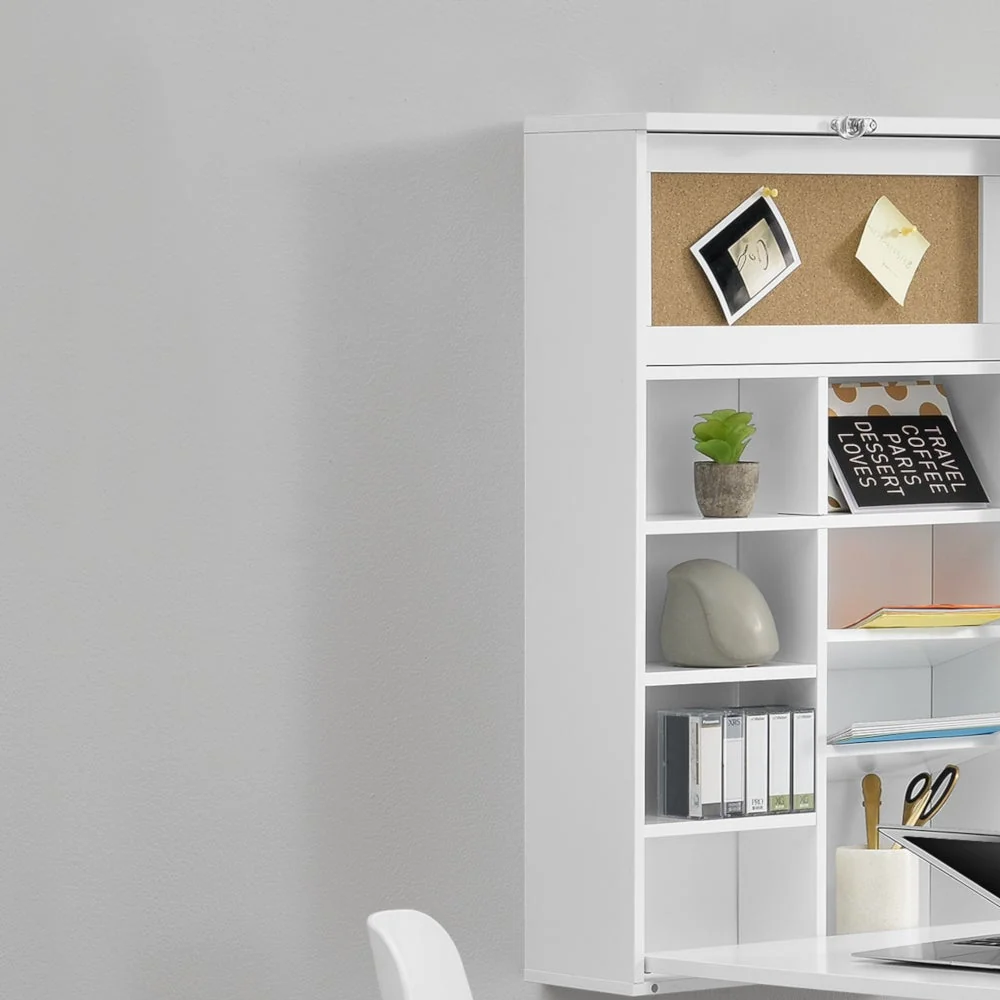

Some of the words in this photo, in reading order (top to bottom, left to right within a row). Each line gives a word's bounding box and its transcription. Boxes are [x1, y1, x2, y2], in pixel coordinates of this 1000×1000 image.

[837, 433, 877, 488] LOVES
[854, 421, 906, 497] DESSERT
[882, 433, 922, 486] PARIS
[901, 424, 949, 494] COFFEE
[924, 425, 967, 493] TRAVEL
